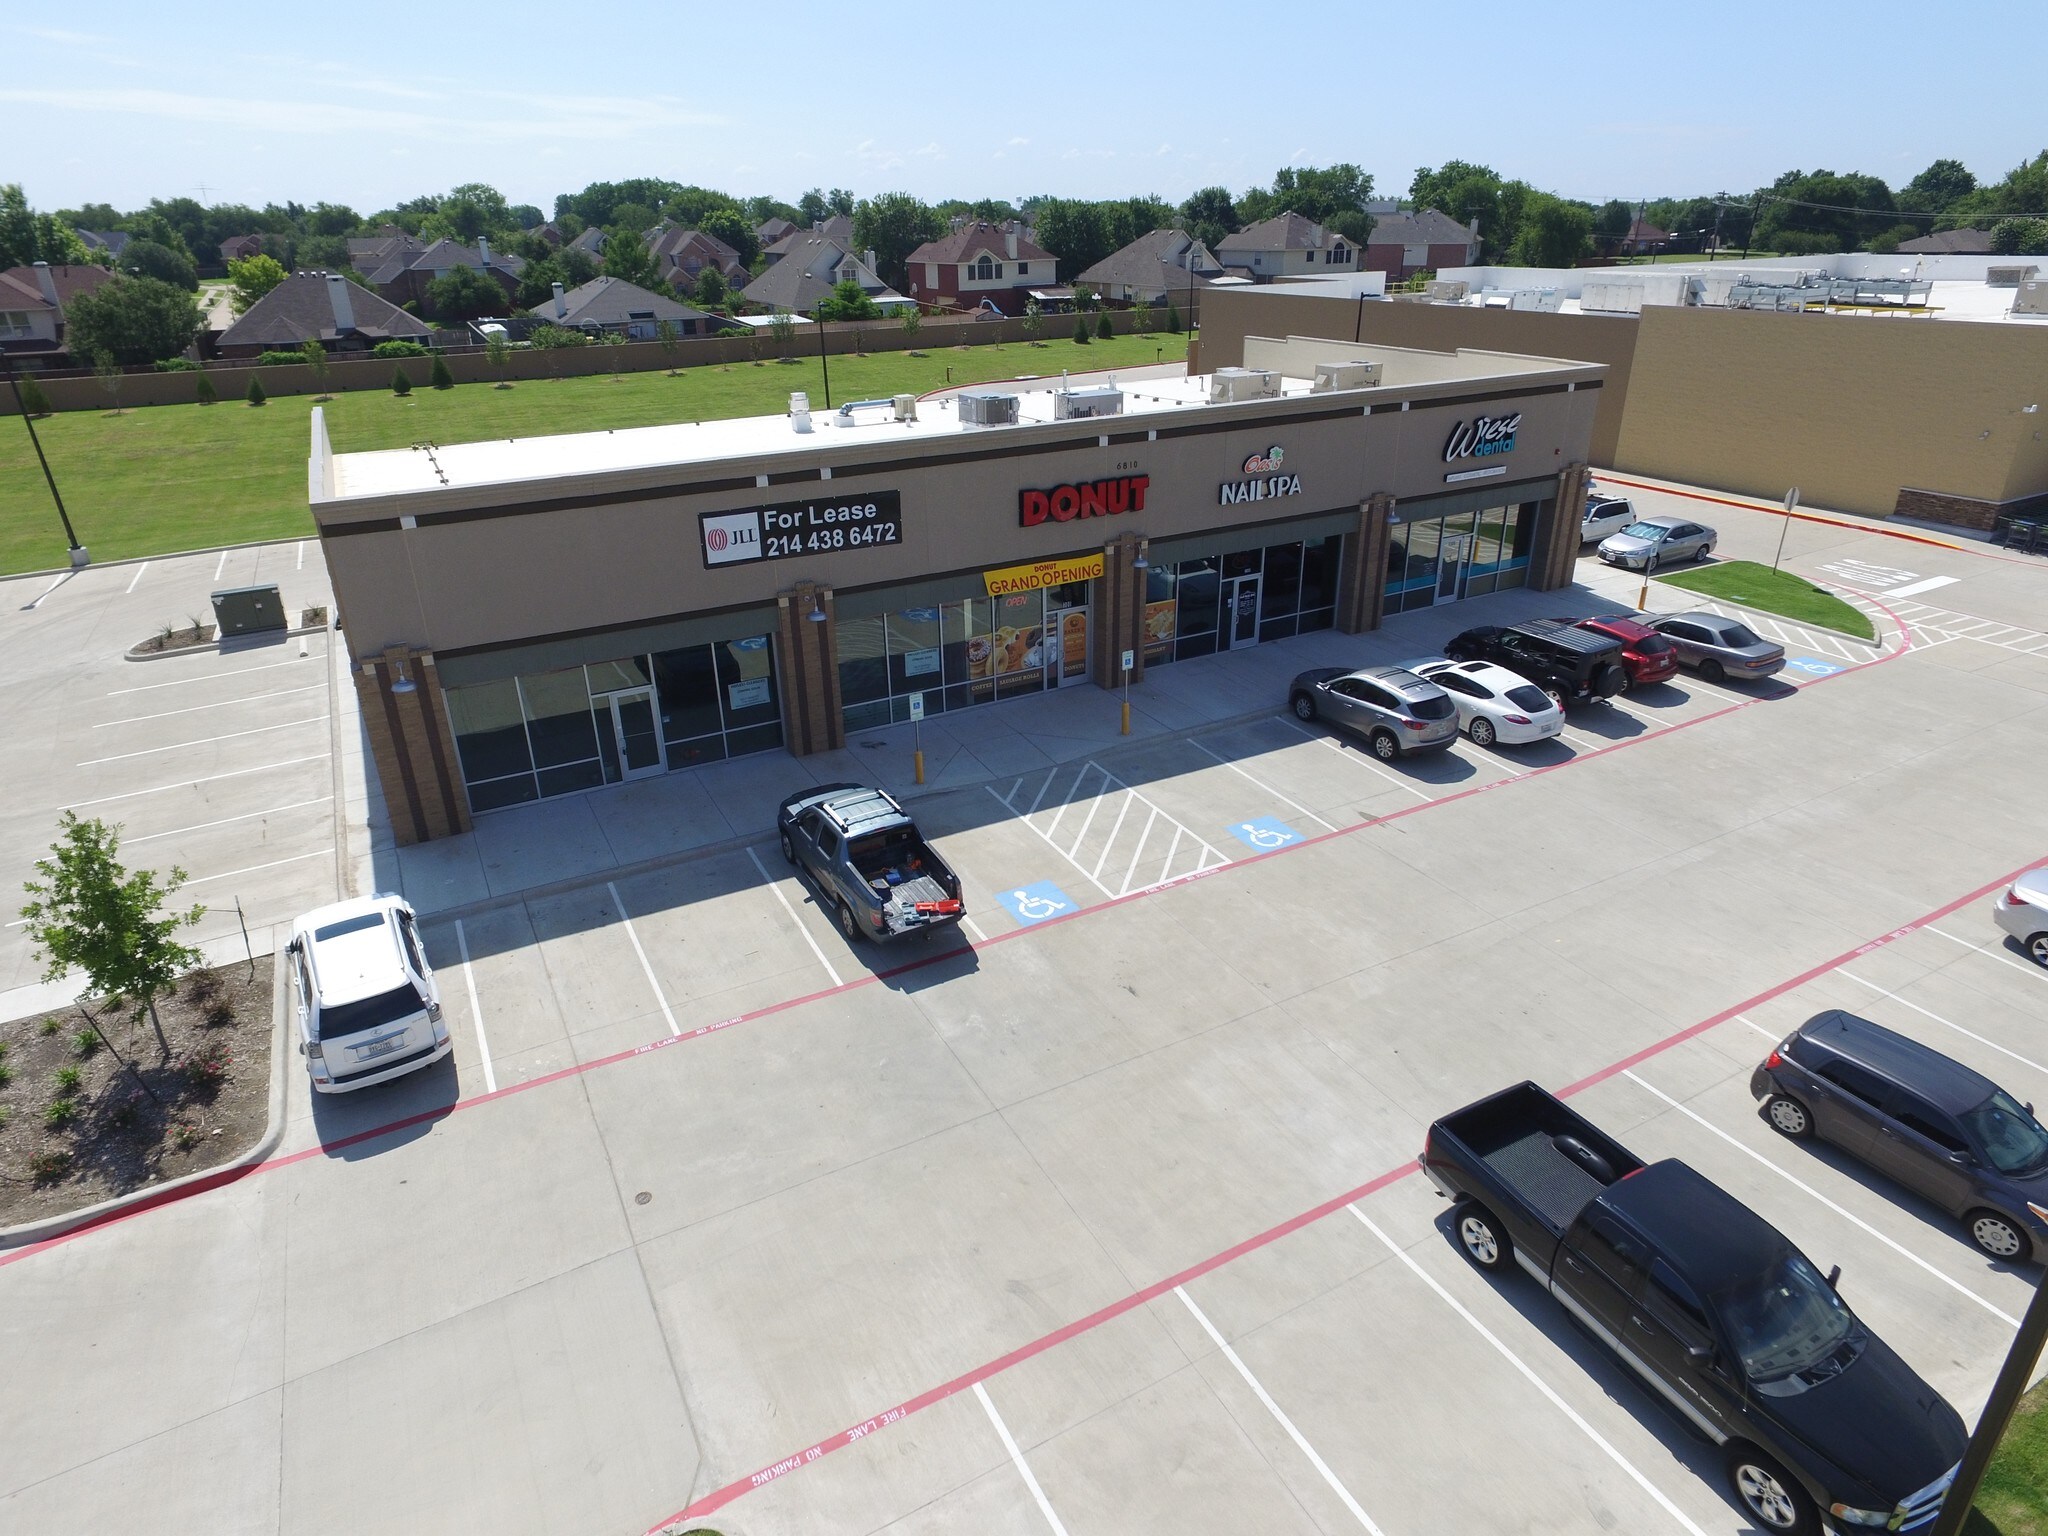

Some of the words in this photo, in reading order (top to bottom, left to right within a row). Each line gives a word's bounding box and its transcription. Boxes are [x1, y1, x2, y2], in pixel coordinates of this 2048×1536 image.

[1446, 414, 1522, 462] Wiese
[1475, 431, 1516, 457] dental
[1116, 461, 1138, 470] 6810
[1244, 448, 1283, 474] Oasis
[1021, 475, 1150, 527] DONUT
[1221, 480, 1263, 505] NAIL
[1268, 474, 1302, 499] SPA
[764, 510, 802, 530] For
[809, 503, 877, 525] Lease
[730, 528, 758, 545] JLL
[767, 535, 802, 556] 214
[808, 529, 844, 550] 438
[849, 522, 896, 545] 6472
[990, 573, 1039, 594] GRAND
[1042, 563, 1101, 586] OPENING
[1034, 563, 1057, 573] DONUT
[1005, 595, 1028, 607] OPEN
[634, 1046, 653, 1055] FIRE
[657, 1037, 678, 1047] LANE
[696, 1027, 706, 1035] NO
[710, 1017, 742, 1030] PARKING
[880, 1406, 906, 1426] FIRE
[847, 1420, 877, 1441] LANE
[806, 1446, 822, 1460] NO
[752, 1456, 800, 1485] PARKING
